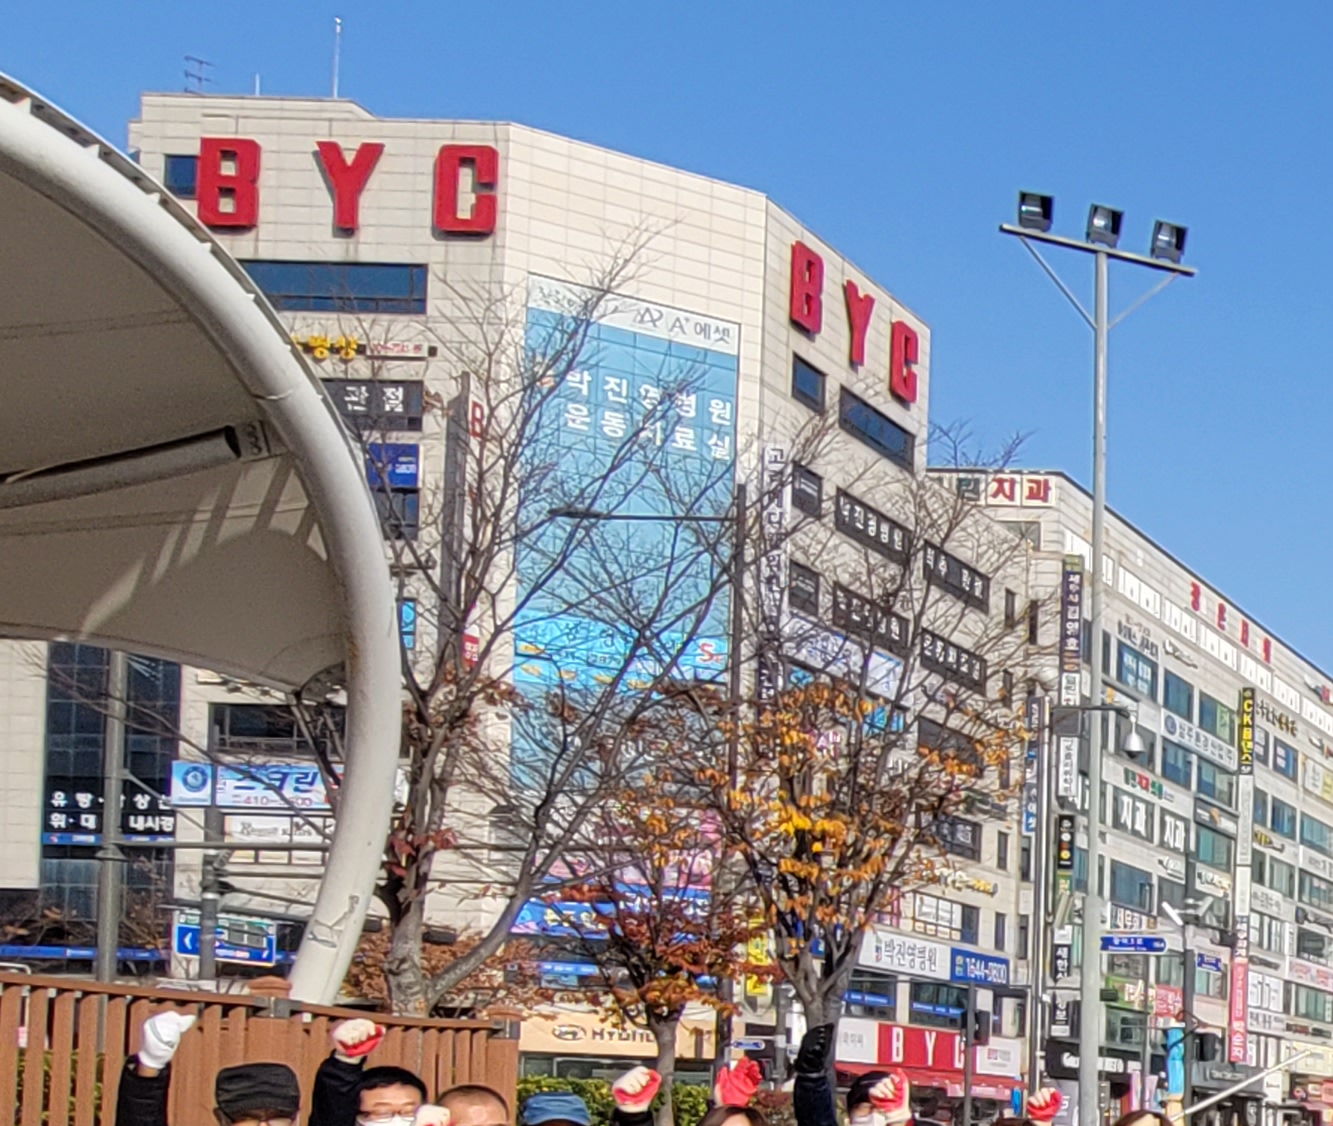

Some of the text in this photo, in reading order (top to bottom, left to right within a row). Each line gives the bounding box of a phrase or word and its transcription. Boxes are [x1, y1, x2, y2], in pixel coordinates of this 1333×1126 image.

[197, 137, 499, 235] BYC
[790, 240, 919, 404] BYC
[892, 1026, 966, 1069] BYC
